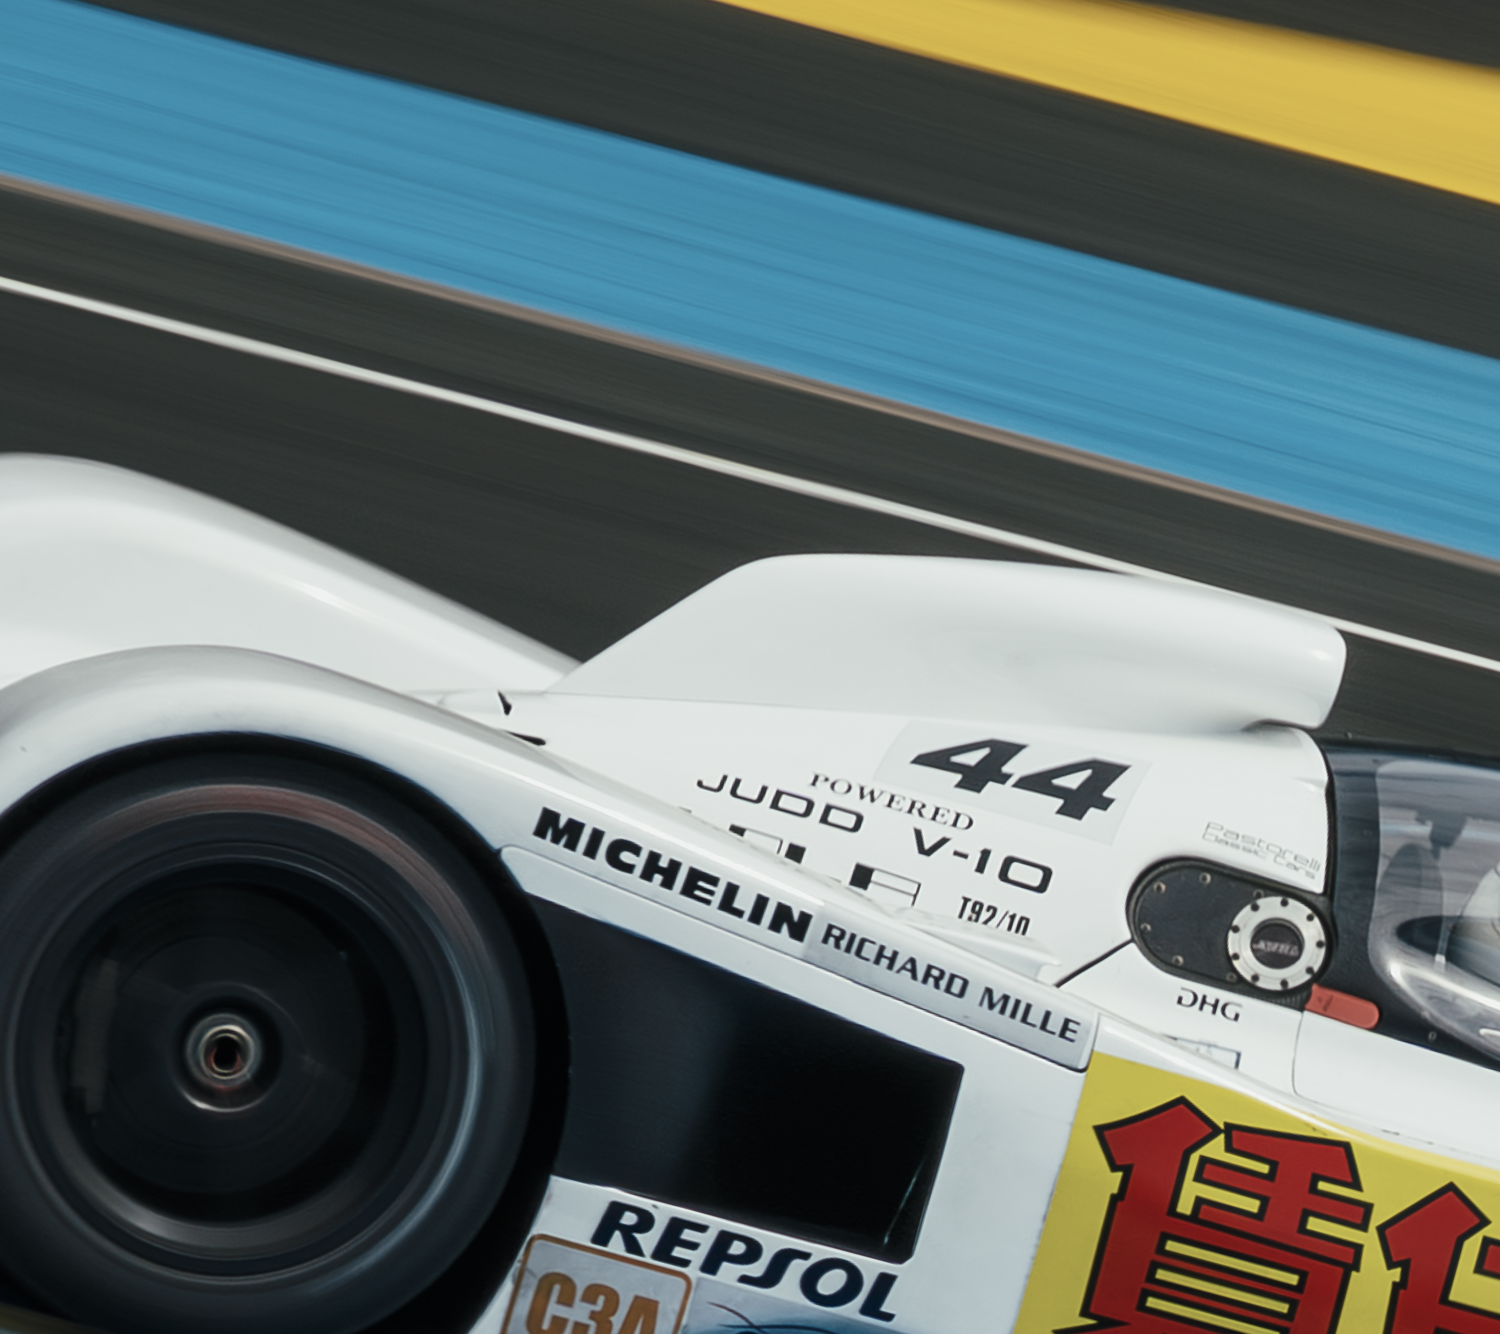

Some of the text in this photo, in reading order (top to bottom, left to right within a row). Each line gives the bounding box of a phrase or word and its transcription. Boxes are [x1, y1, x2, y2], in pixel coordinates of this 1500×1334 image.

[809, 772, 974, 831] POWERED
[910, 738, 1133, 821] 44
[533, 806, 813, 943] MICHELIN
[697, 774, 865, 833] JUDD
[912, 827, 1053, 894] V-10
[1202, 833, 1315, 880] Classic Cars
[1204, 822, 1321, 872] Pastorelli
[821, 924, 1081, 1043] RICHARD MILLE
[1177, 987, 1242, 1022] DHG
[590, 1200, 898, 1322] REPSOL
